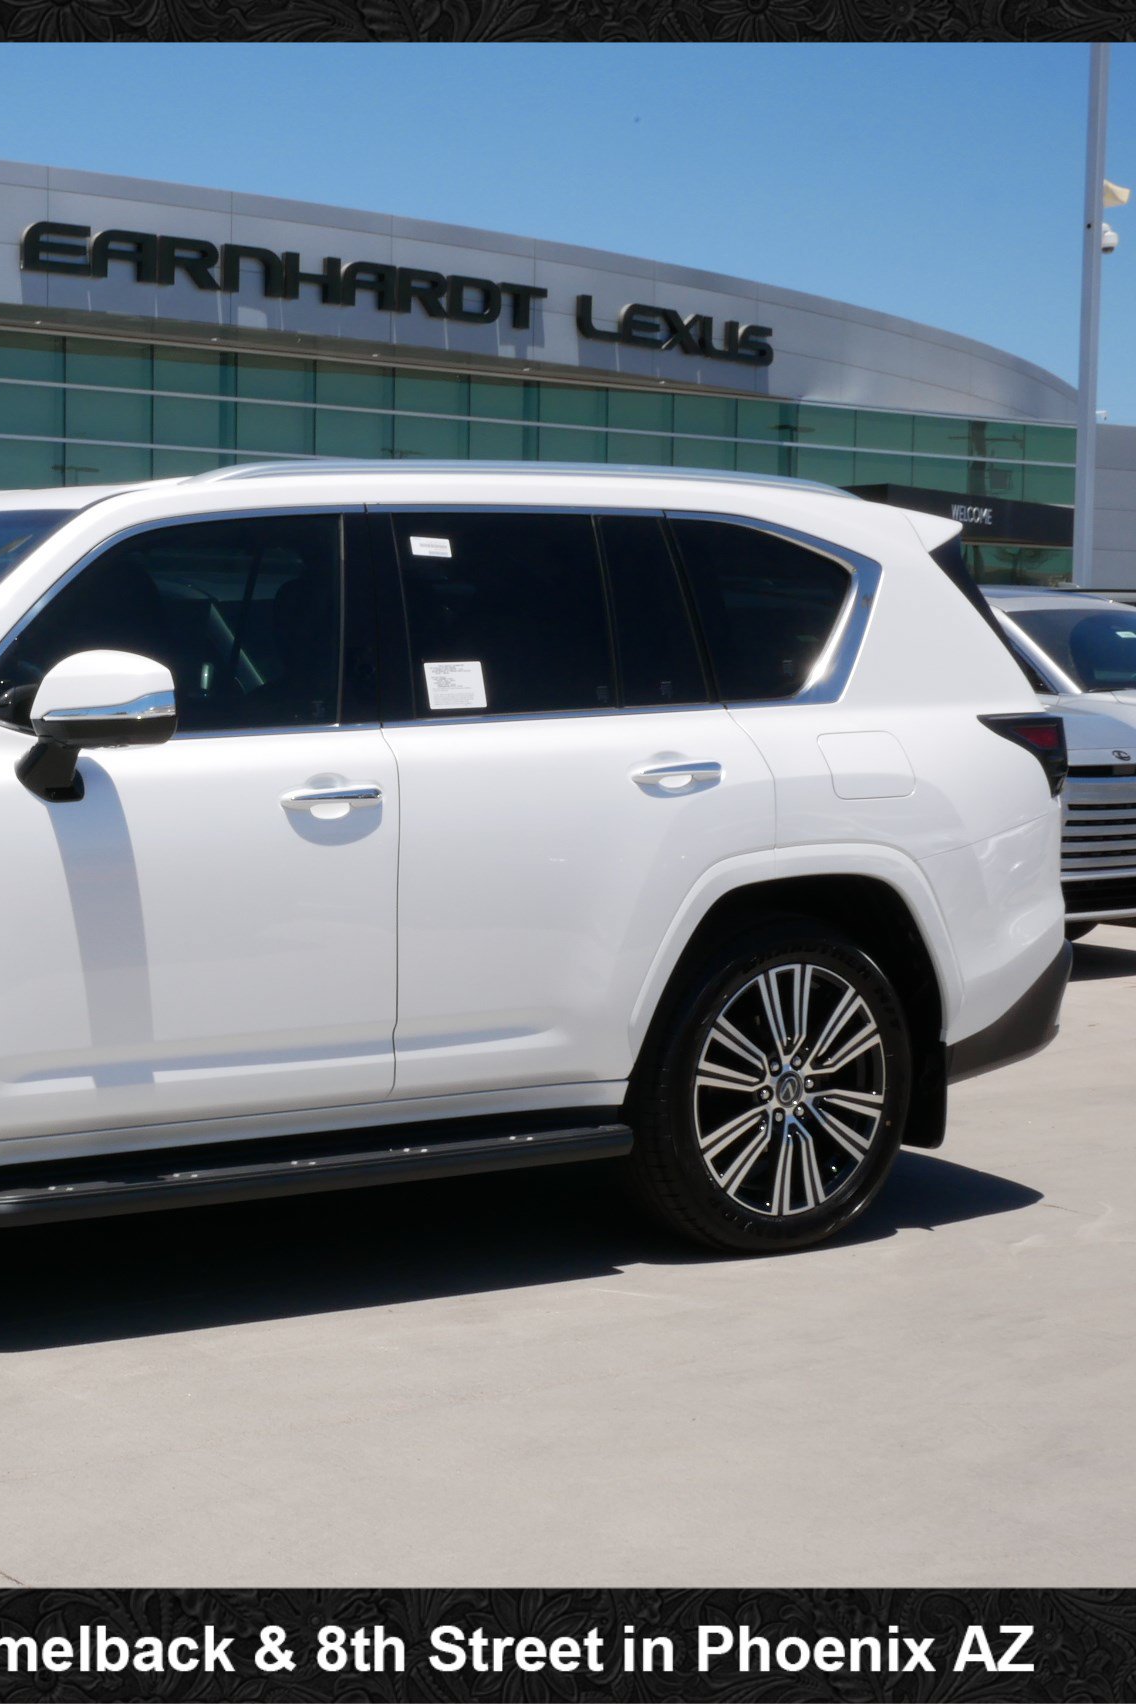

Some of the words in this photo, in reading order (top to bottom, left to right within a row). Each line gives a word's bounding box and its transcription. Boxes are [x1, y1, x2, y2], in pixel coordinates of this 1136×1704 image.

[20, 220, 548, 330] EARNHARDT
[576, 294, 774, 367] LEXUS
[951, 504, 993, 525] WELCOME
